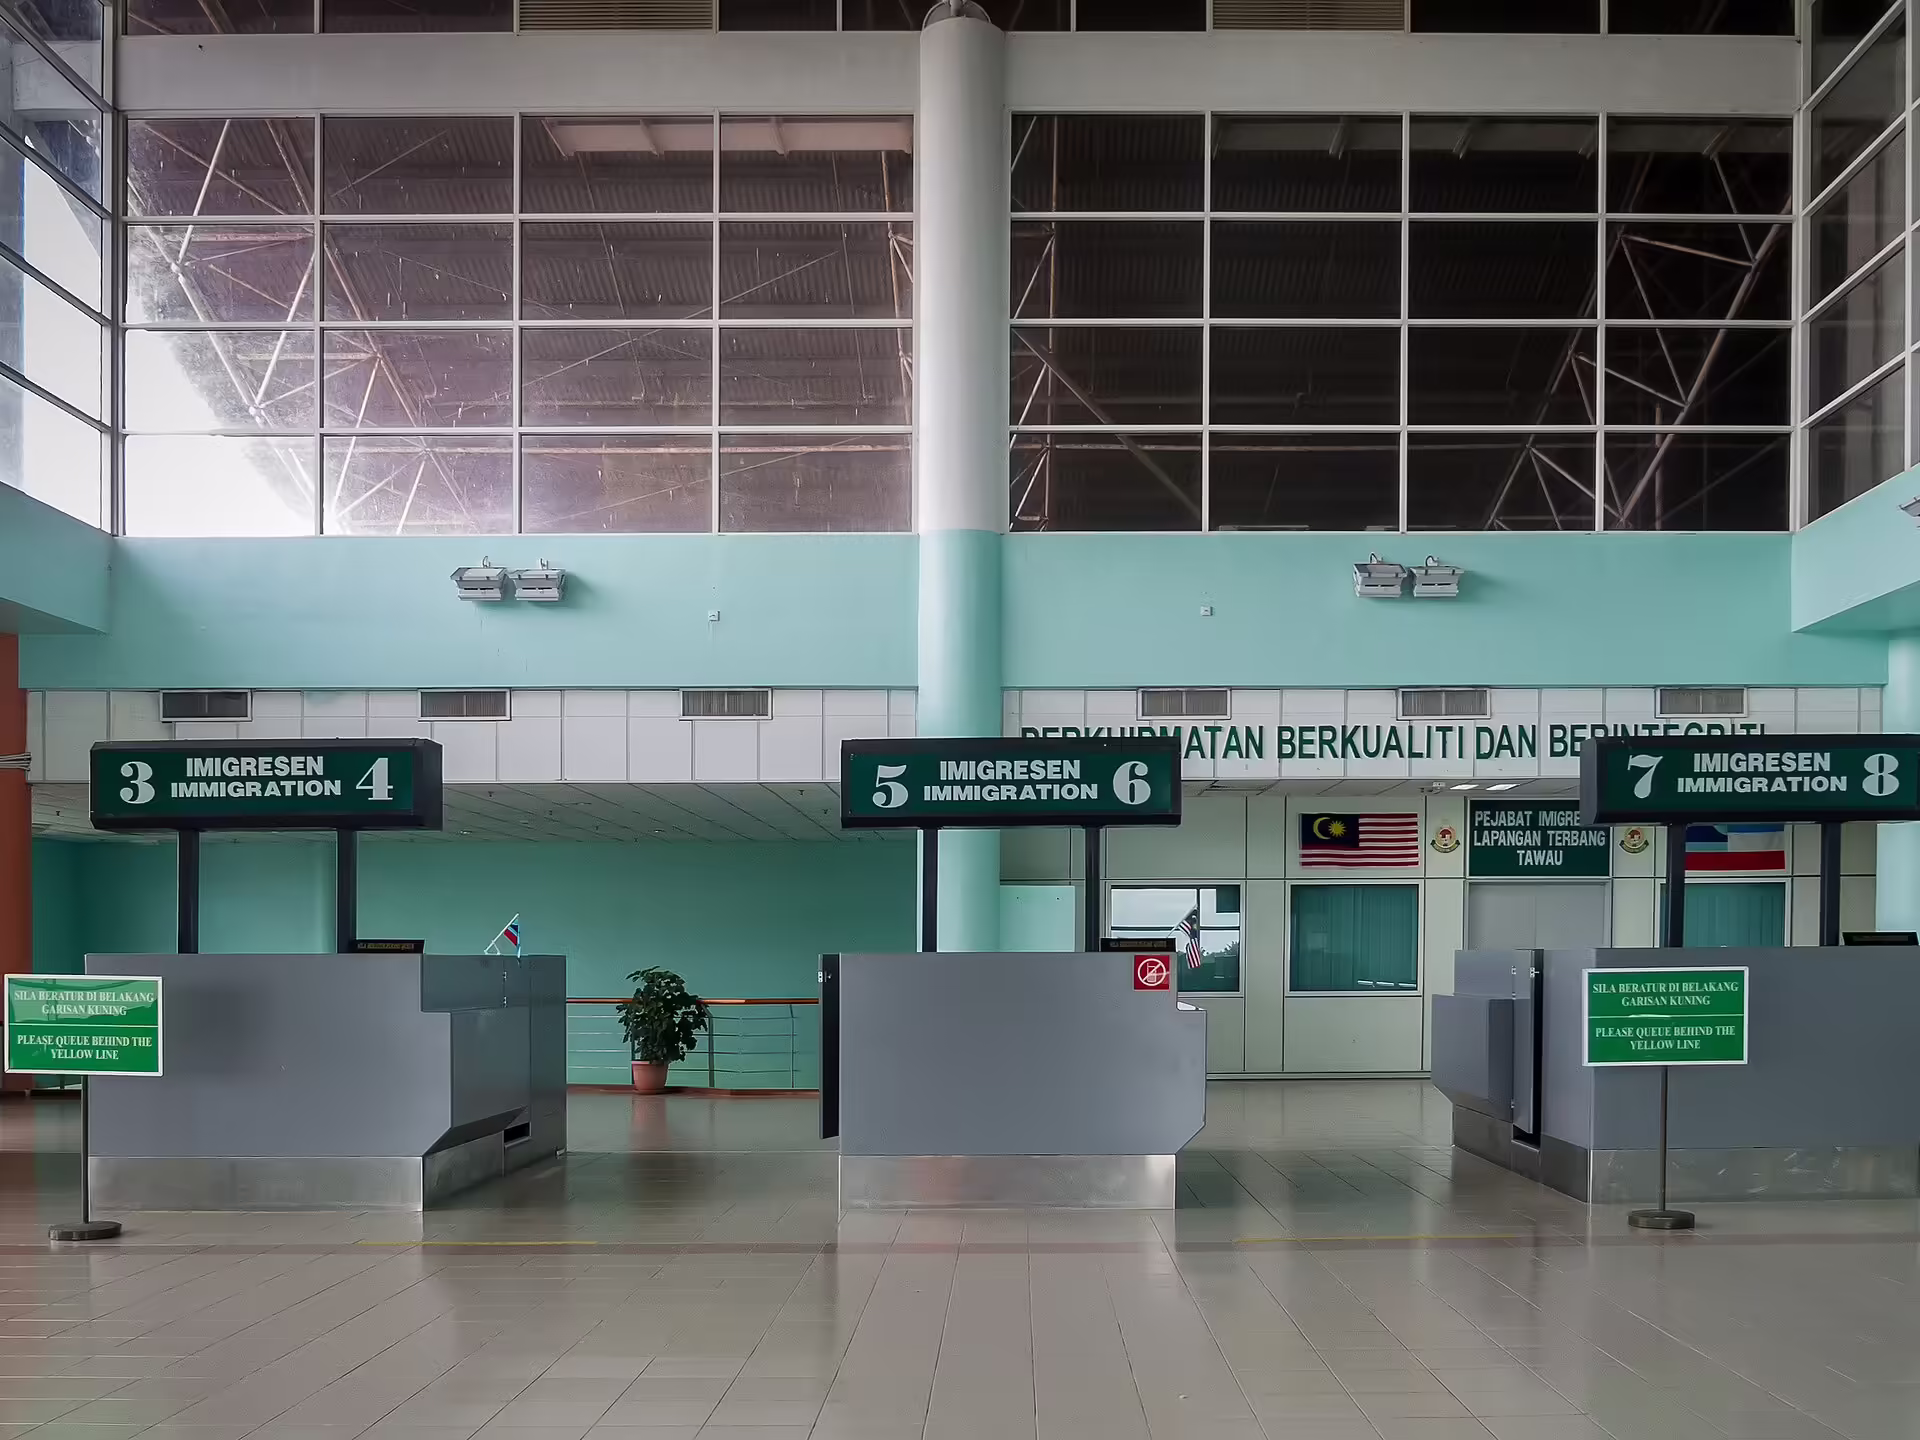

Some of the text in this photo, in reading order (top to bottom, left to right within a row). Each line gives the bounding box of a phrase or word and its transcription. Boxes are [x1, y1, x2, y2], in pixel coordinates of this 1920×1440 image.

[1277, 725, 1464, 759] BERKUALITI
[1476, 725, 1536, 760] DAN
[187, 756, 323, 777] IMIGRESEN
[940, 760, 1080, 780] IMIGRESEN
[1694, 752, 1830, 772] IMIGRESEN
[120, 761, 155, 804] 3
[356, 758, 393, 800] 4
[1113, 761, 1150, 805] 6
[1627, 754, 1663, 798] 7
[1862, 754, 1899, 796] 8
[171, 780, 341, 798] IMMIGRATION
[872, 765, 908, 808] 5
[1677, 776, 1847, 792] IMMIGRATION
[924, 784, 1098, 801] IMMIGRATION
[1475, 811, 1580, 826] PEJABAT IMIGRE
[1474, 830, 1605, 846] LAPANGAN TERBANG
[1517, 850, 1562, 865] TAWAU
[1593, 982, 1738, 993] SILA BERATUR DI BELAKANG
[15, 991, 154, 1002] SILA BERATUR DI BELAKANG
[1622, 996, 1710, 1006] GARISAN KUNING
[42, 1005, 126, 1015] GARISAN KUNING
[1596, 1026, 1735, 1038] PLEASE QUEUE BEHIND THE
[17, 1035, 152, 1047] PLEASE QUEUE BEHIND THE
[1630, 1040, 1700, 1050] YELLOW LINE
[50, 1049, 118, 1059] YELLOW LINE
